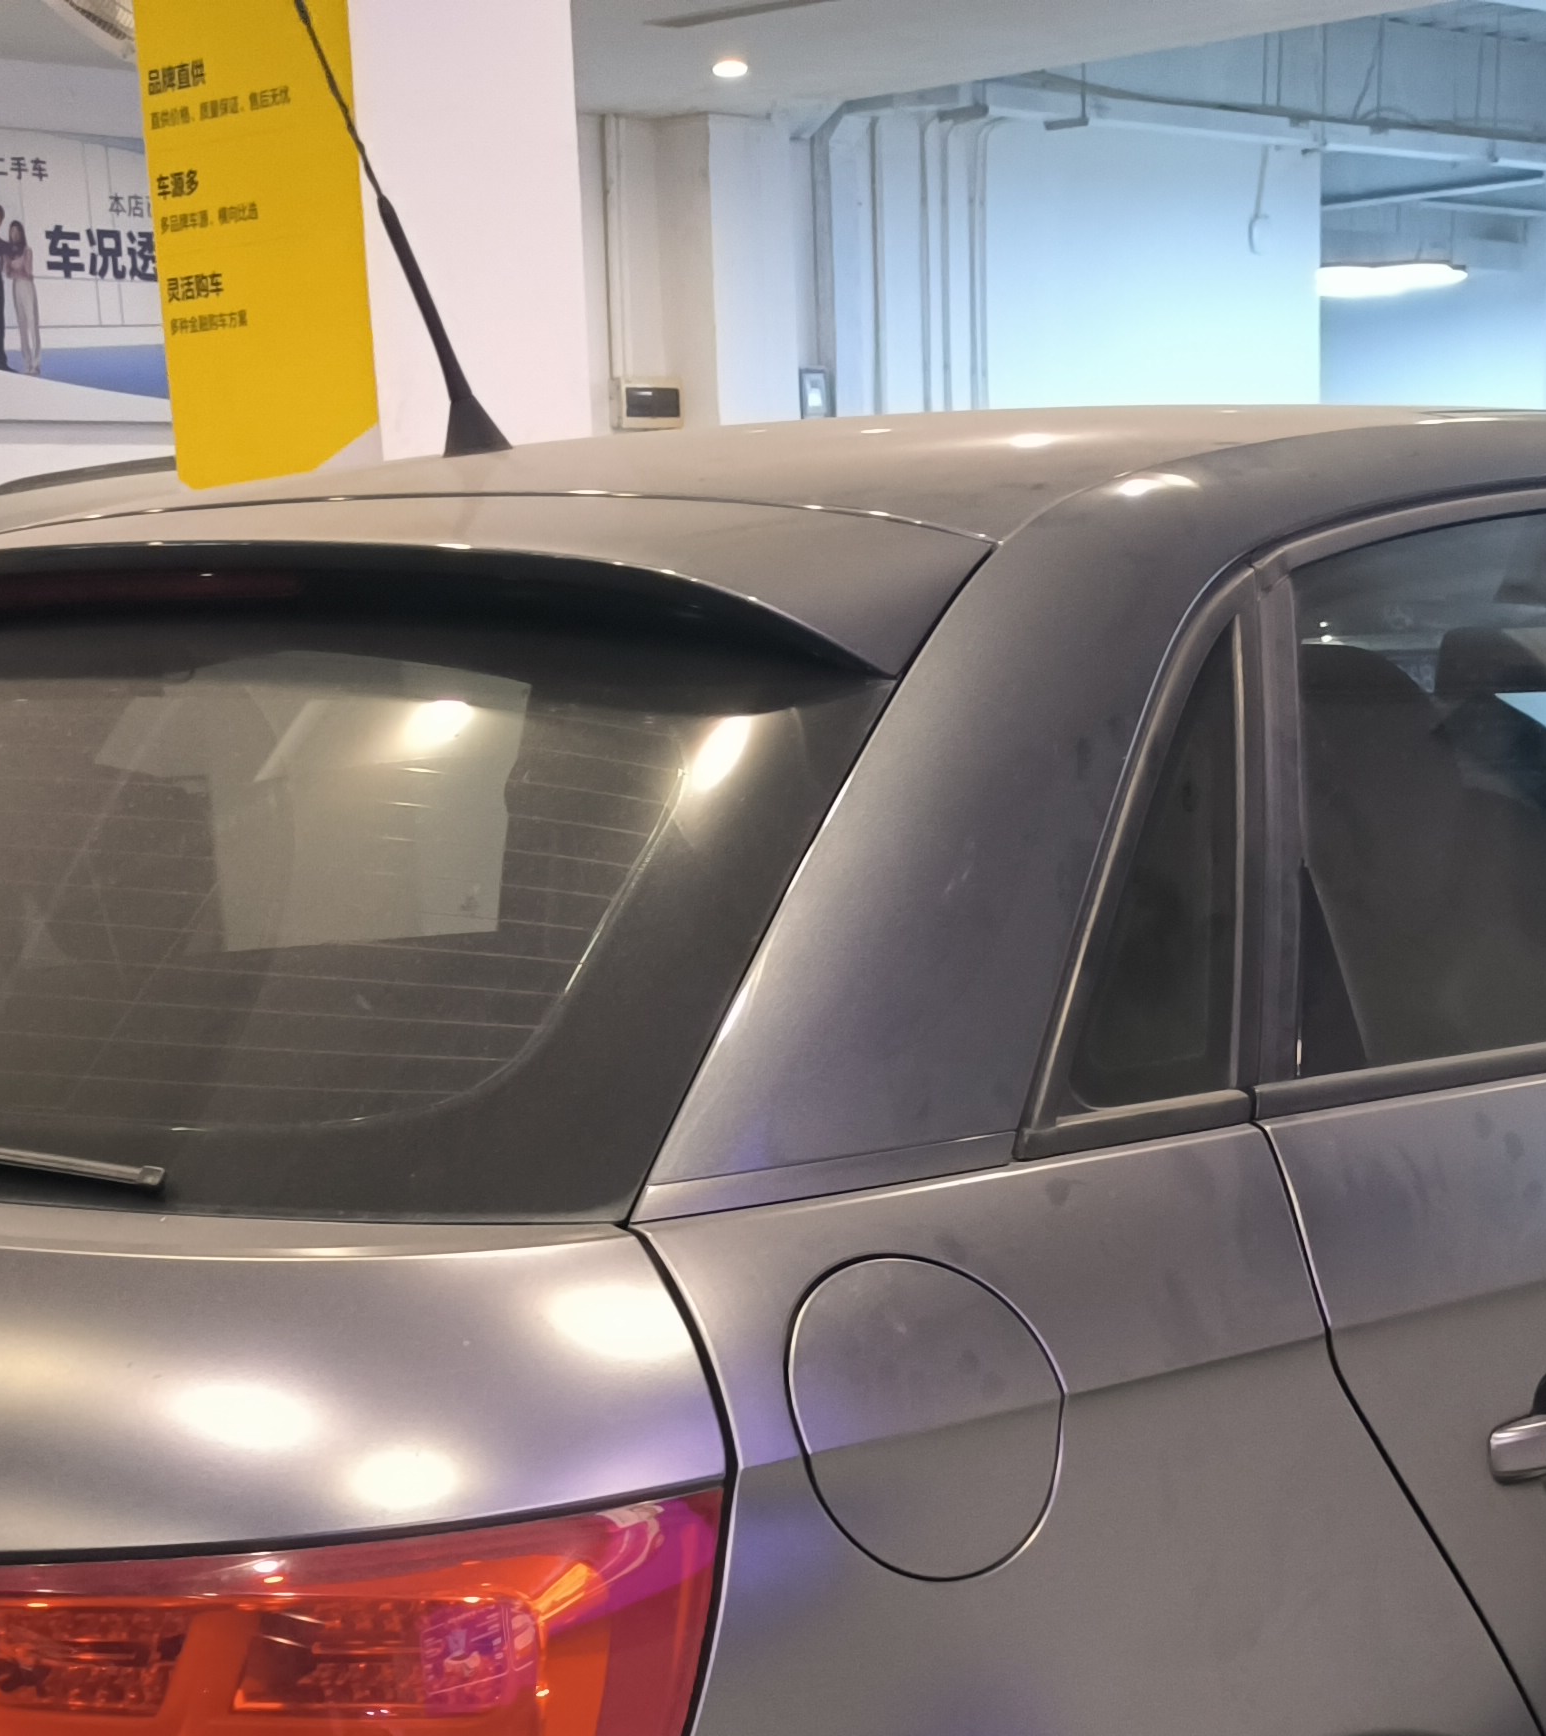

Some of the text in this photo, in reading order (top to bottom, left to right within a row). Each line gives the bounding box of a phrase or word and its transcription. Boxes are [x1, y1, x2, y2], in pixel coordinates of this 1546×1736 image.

[147, 58, 206, 95] 品牌直供
[156, 168, 199, 199] 车源多
[166, 271, 224, 303] 灵活购车
